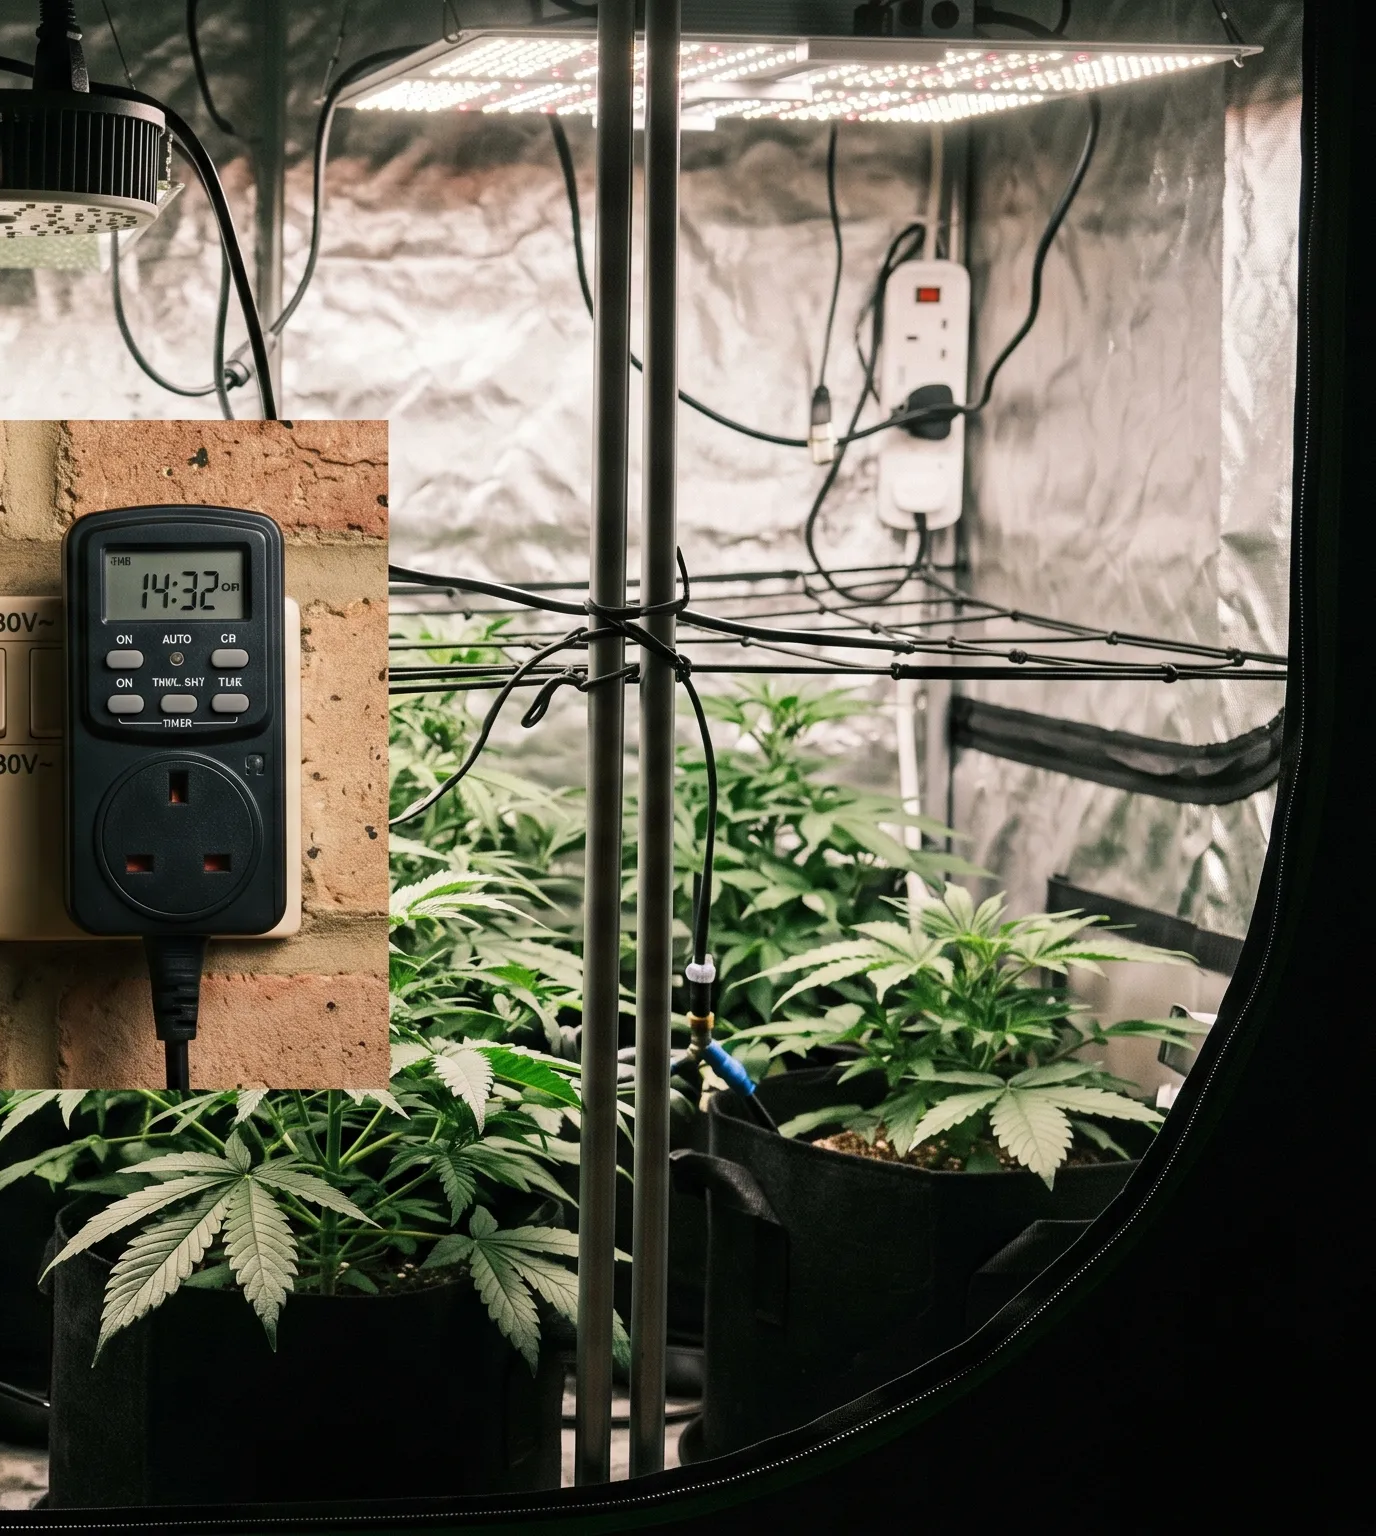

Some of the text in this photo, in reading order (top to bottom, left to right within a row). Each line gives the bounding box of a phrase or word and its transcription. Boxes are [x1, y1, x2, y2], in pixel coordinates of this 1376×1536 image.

[141, 570, 220, 611] 14:32
[116, 634, 133, 645] ON
[162, 634, 192, 644] AUTO
[116, 678, 133, 688] ON
[162, 718, 193, 728] TIMER
